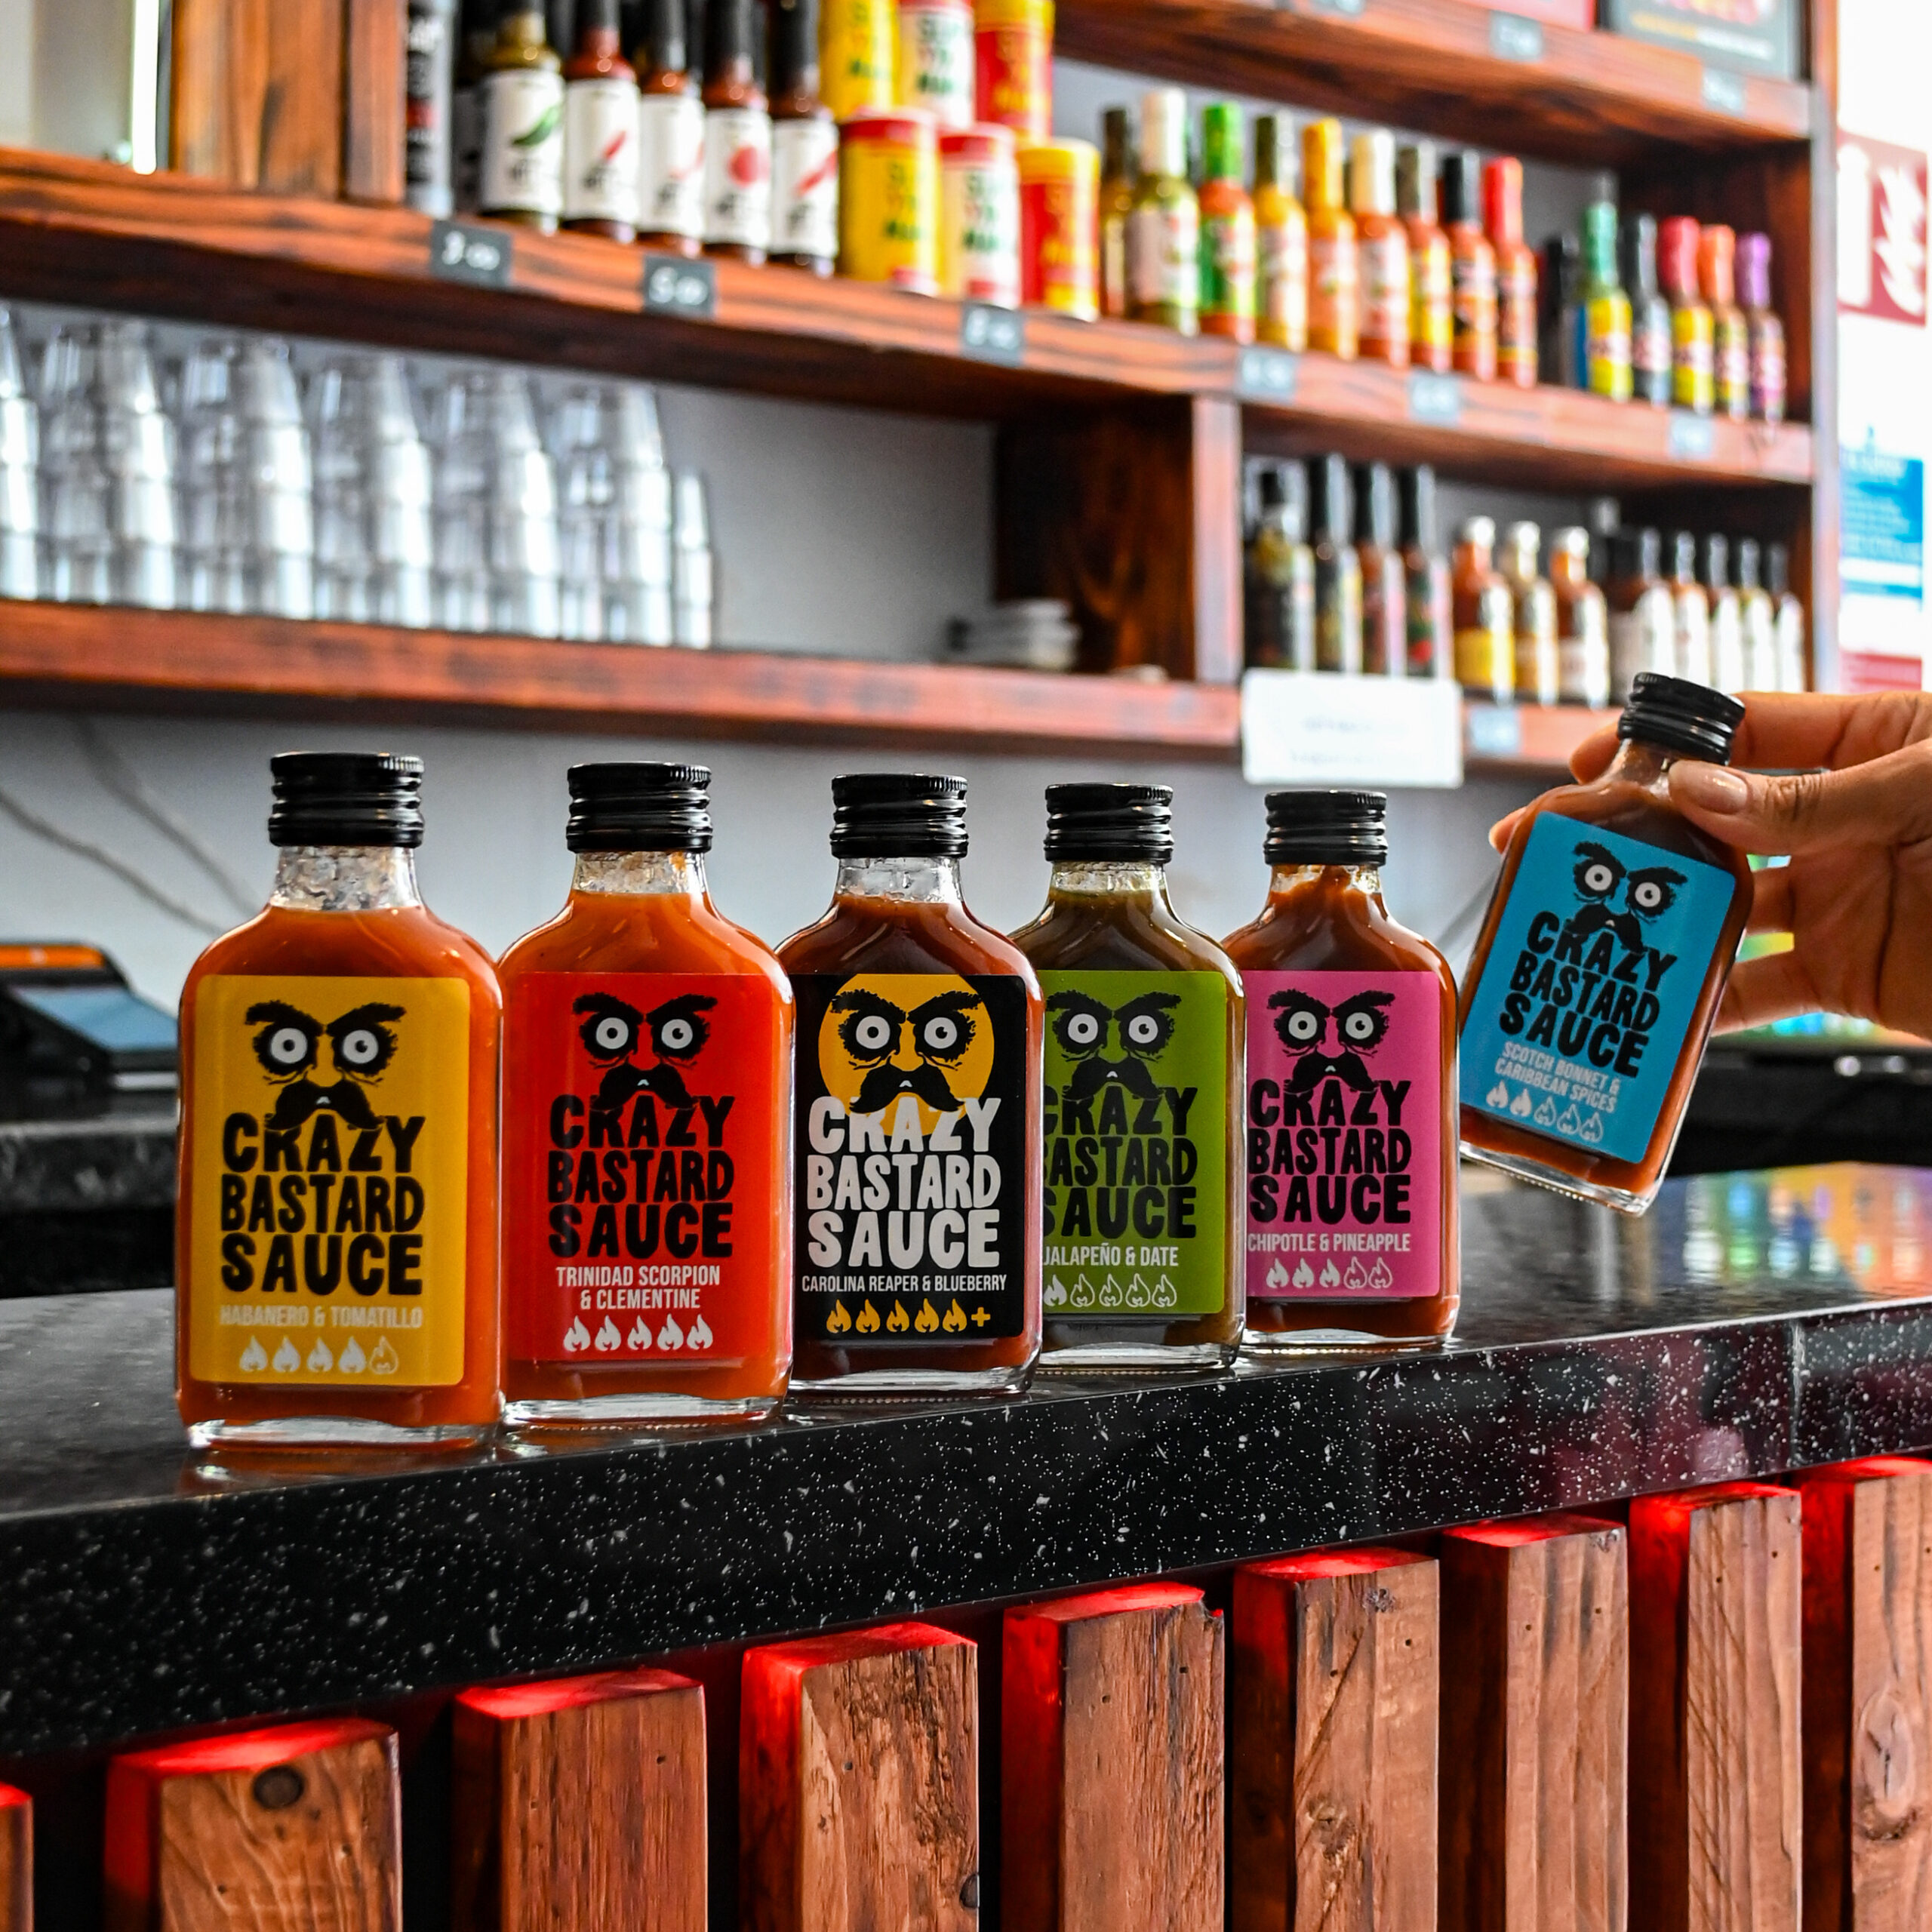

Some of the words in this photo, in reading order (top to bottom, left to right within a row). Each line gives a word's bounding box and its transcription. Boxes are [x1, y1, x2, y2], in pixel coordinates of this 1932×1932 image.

[1527, 910, 1677, 992] CRAZY
[1510, 949, 1660, 1032] BASTARD
[1499, 991, 1650, 1078] SAUCE
[1494, 1057, 1570, 1096] CARIBBEAN
[1569, 1083, 1617, 1113] SPICES
[1502, 1041, 1555, 1072] SCOTCH
[1555, 1059, 1609, 1091] BONNET
[549, 1094, 735, 1149] CRAZY
[808, 1096, 1002, 1154] CRAZY
[1250, 1078, 1411, 1128] CRAZY
[221, 1112, 426, 1173] CRAZY
[1044, 1135, 1198, 1186] ASTARD
[1247, 1128, 1411, 1175] BASTARD
[220, 1174, 425, 1233] BASTARD
[547, 1149, 735, 1204] BASTARD
[807, 1154, 1001, 1211] BASTARD
[1250, 1174, 1411, 1224] SAUCE
[548, 1202, 734, 1259] SAUCE
[808, 1209, 1001, 1269] SAUCE
[1044, 1242, 1121, 1266] JALAPEÑO
[1125, 1246, 1136, 1266] &
[1140, 1246, 1179, 1266] DATE
[1248, 1233, 1315, 1252] CHIPOTLE
[1319, 1233, 1328, 1252] &
[1334, 1233, 1411, 1252] PINEAPPLE
[220, 1233, 424, 1296] SAUCE
[555, 1266, 634, 1287] TRINIDAD
[638, 1265, 721, 1285] SCORPION
[801, 1275, 866, 1292] CAROLINA
[869, 1275, 918, 1292] REAPER
[922, 1275, 931, 1291] &
[934, 1274, 1008, 1292] BLUEBERRY
[220, 1305, 309, 1327] HABANERO
[313, 1305, 326, 1327] &
[330, 1306, 423, 1328] TOMATILLO
[580, 1290, 592, 1310] &
[596, 1288, 701, 1309] CLEMENTINE
